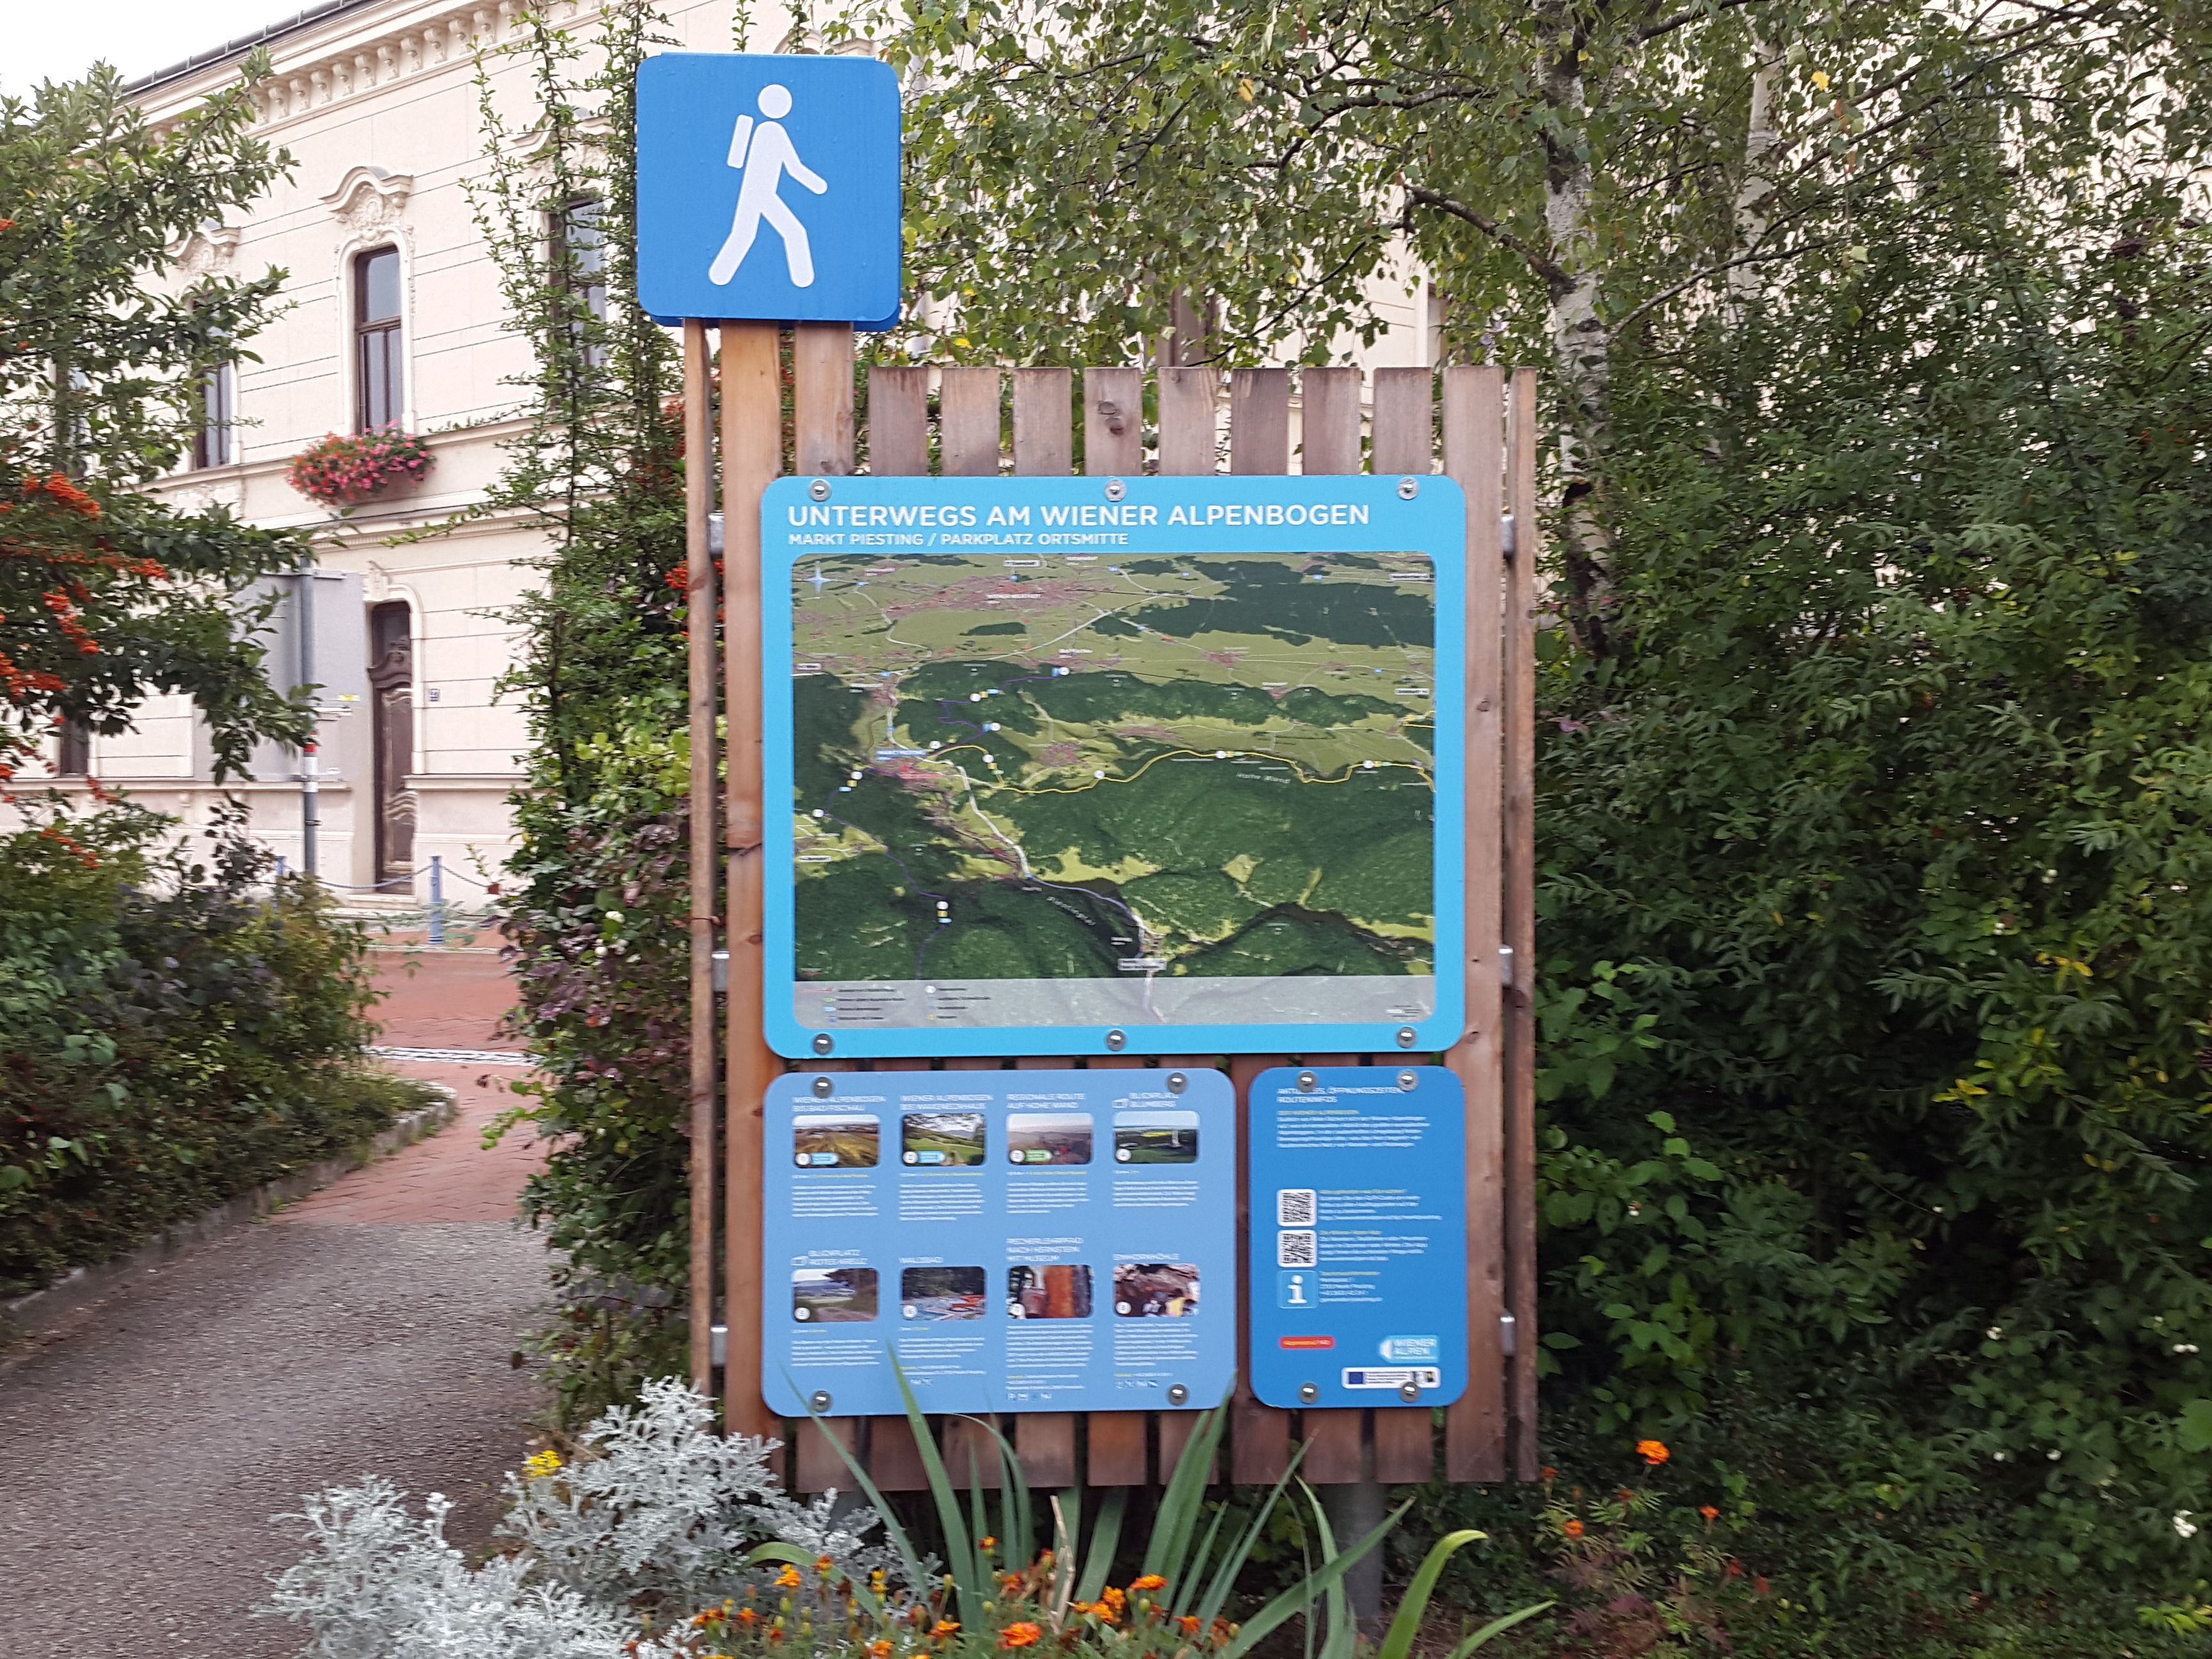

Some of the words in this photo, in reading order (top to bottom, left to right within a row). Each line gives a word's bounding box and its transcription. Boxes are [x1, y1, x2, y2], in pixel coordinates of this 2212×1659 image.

[788, 505, 977, 527] UNTERWEGS
[986, 505, 1030, 527] AM
[1040, 505, 1158, 527] WIENER
[1167, 504, 1370, 527] ALPENBOGEN
[788, 533, 845, 545] MARKT
[849, 533, 924, 545] PIESTING
[940, 533, 1034, 545] PARKPLATZ
[1038, 533, 1129, 545] ORTSMITTE
